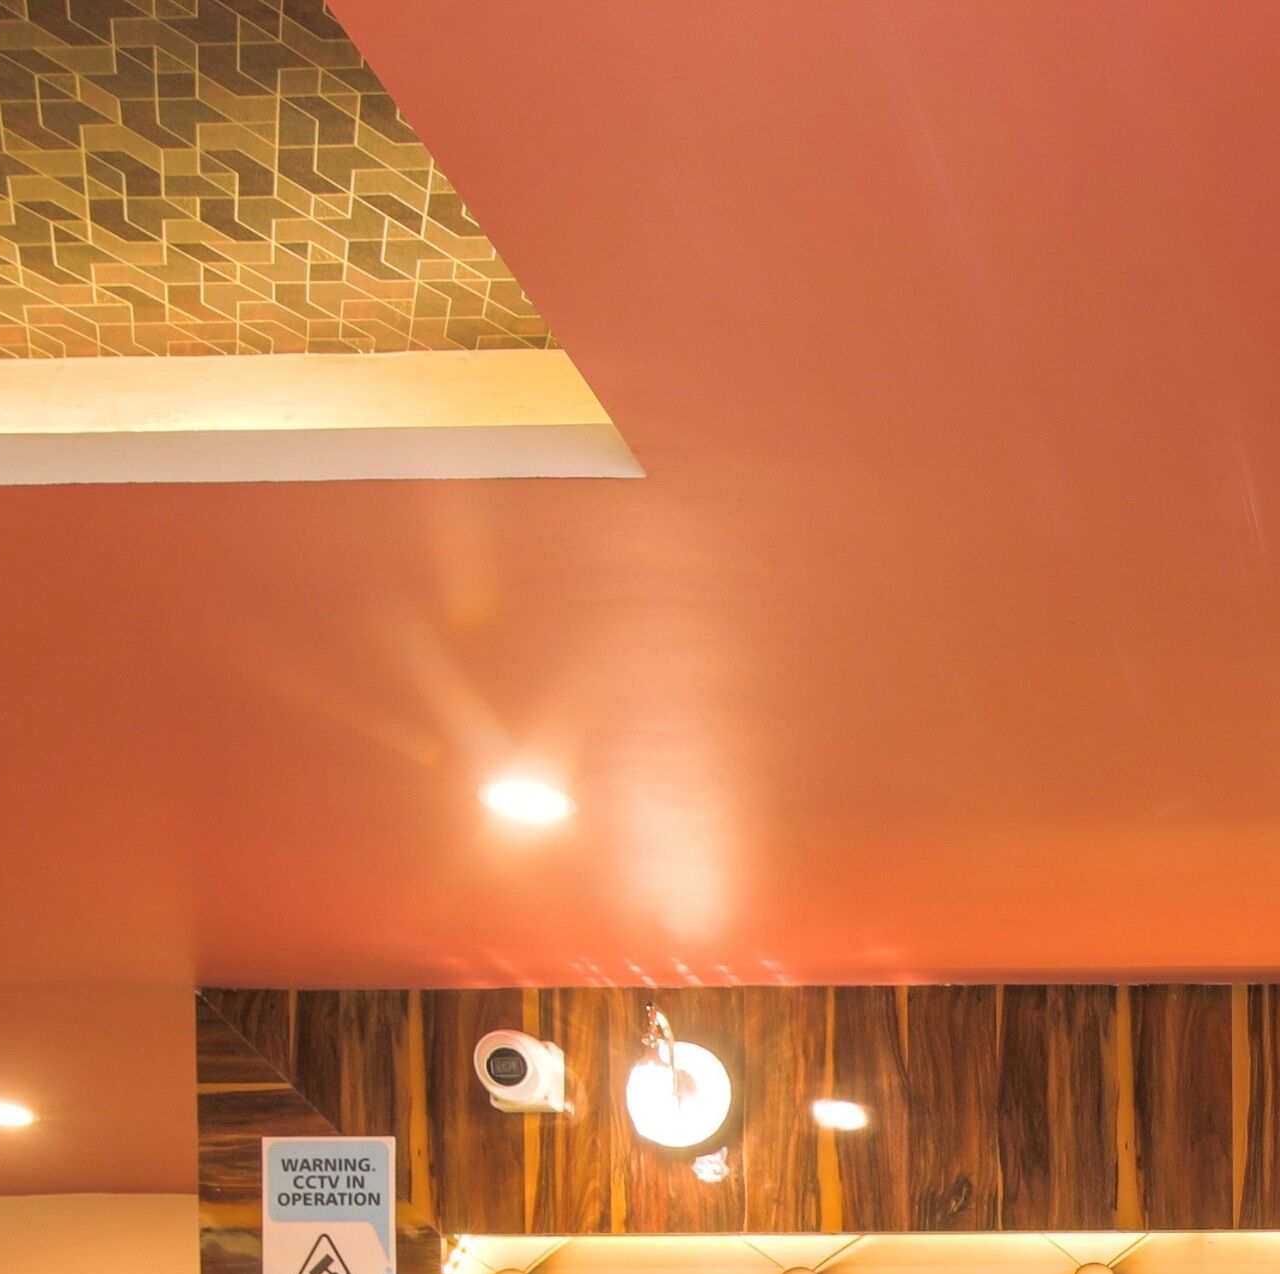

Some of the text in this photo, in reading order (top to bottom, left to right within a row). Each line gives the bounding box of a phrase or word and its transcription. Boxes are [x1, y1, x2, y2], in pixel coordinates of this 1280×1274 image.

[281, 1158, 376, 1172] WARNING.
[292, 1175, 365, 1189] CCTV IN
[277, 1192, 381, 1206] OPERATION
